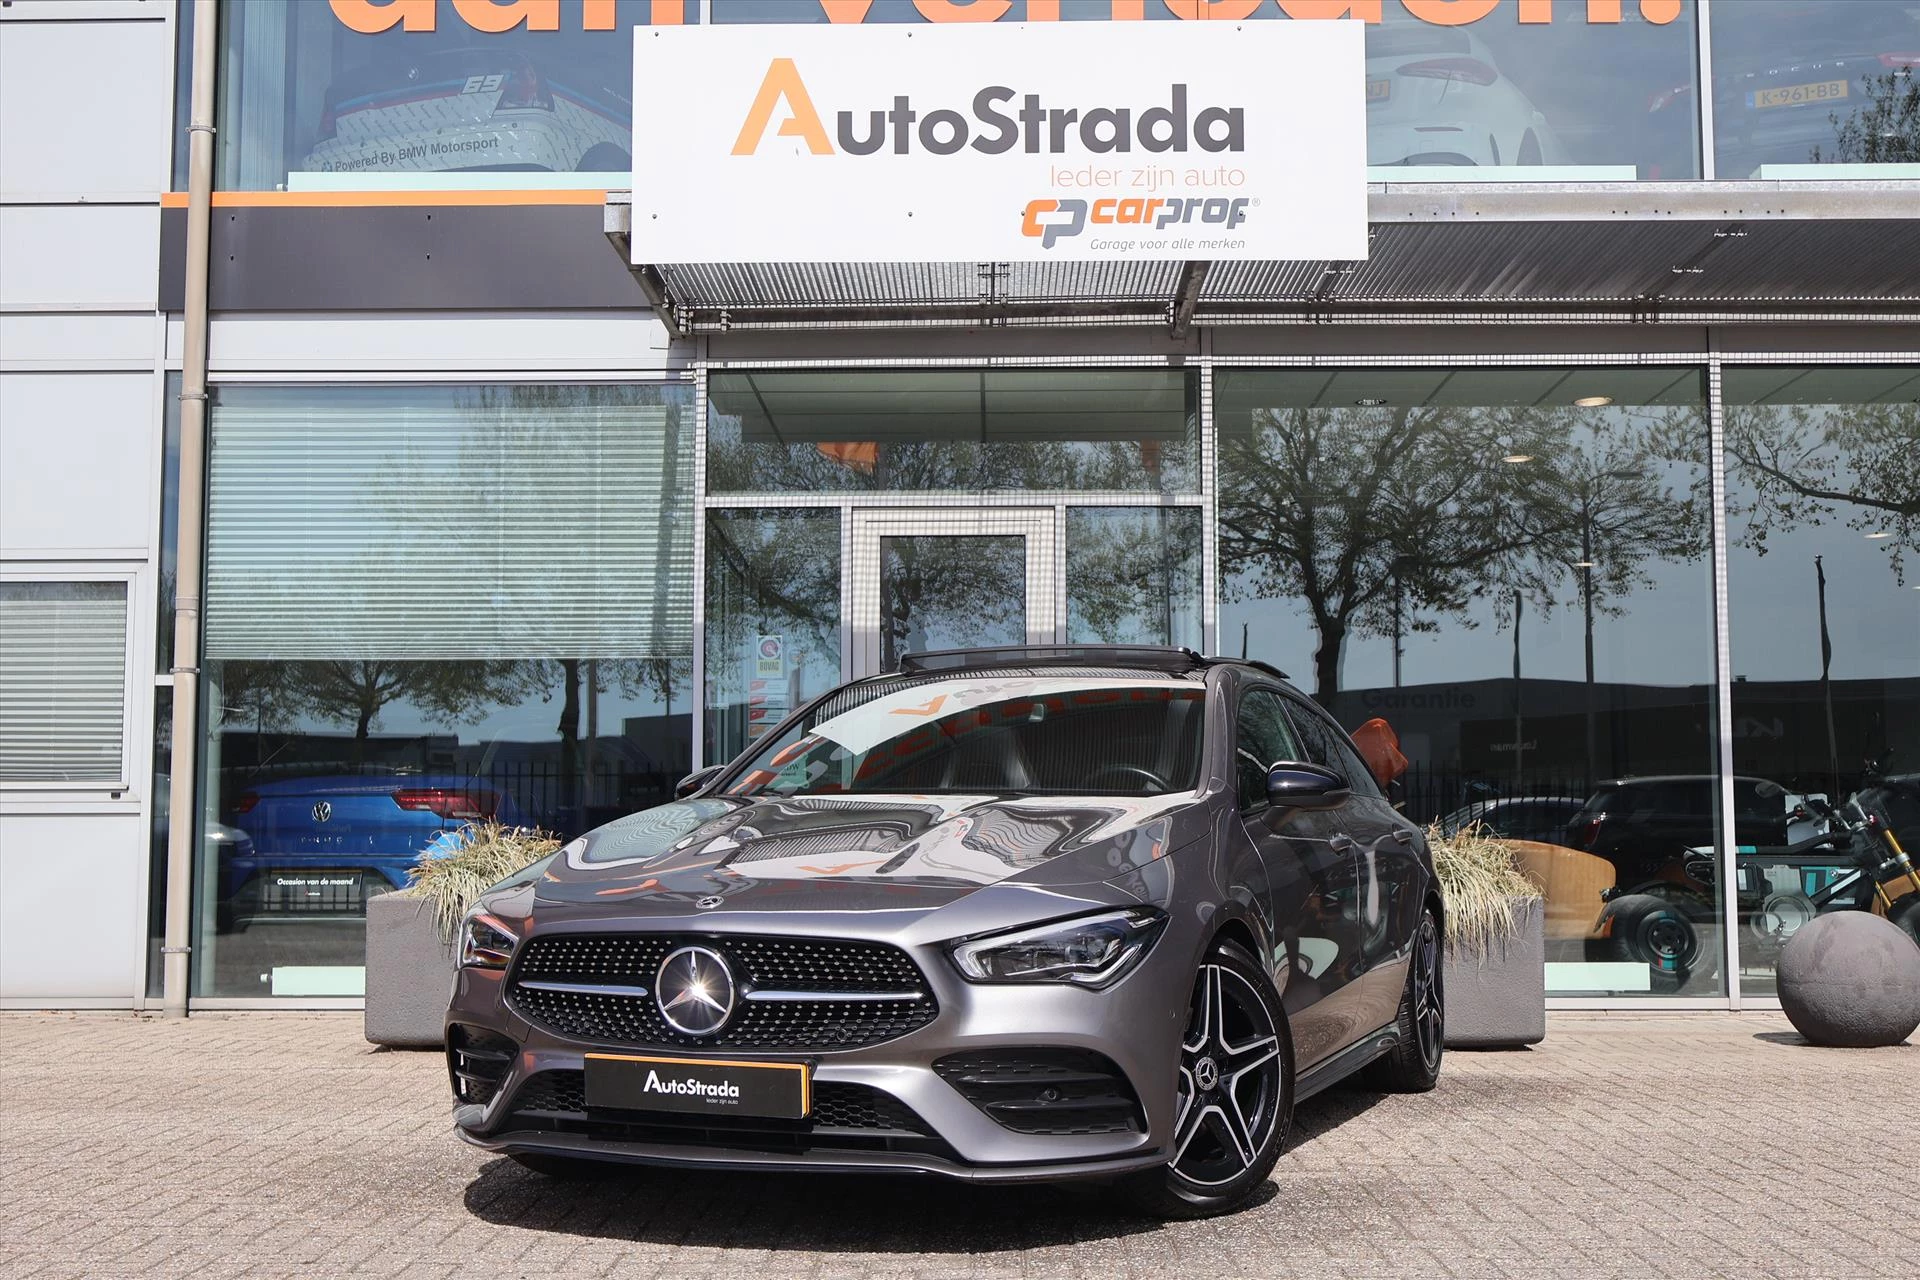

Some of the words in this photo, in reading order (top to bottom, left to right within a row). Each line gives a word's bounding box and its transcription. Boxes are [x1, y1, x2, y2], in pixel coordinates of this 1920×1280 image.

[462, 74, 505, 95] 69
[1762, 83, 1840, 104] K-961-BB
[730, 57, 1245, 156] AutoStrada
[335, 151, 378, 172] Powered
[381, 151, 396, 165] By
[398, 144, 428, 162] BMW
[430, 136, 499, 156] Motorsport
[1051, 165, 1123, 187] Ieder
[1131, 164, 1175, 192] zijn
[1185, 165, 1246, 187] auto
[1090, 238, 1136, 252] Garage
[1139, 239, 1168, 250] voor
[1172, 238, 1194, 250] alle
[1198, 238, 1246, 249] merken
[1361, 687, 1476, 710] Garantie
[277, 878, 306, 886] Occasion
[320, 878, 329, 886] de
[330, 878, 354, 886] maand
[643, 1069, 740, 1098] AutoStrada
